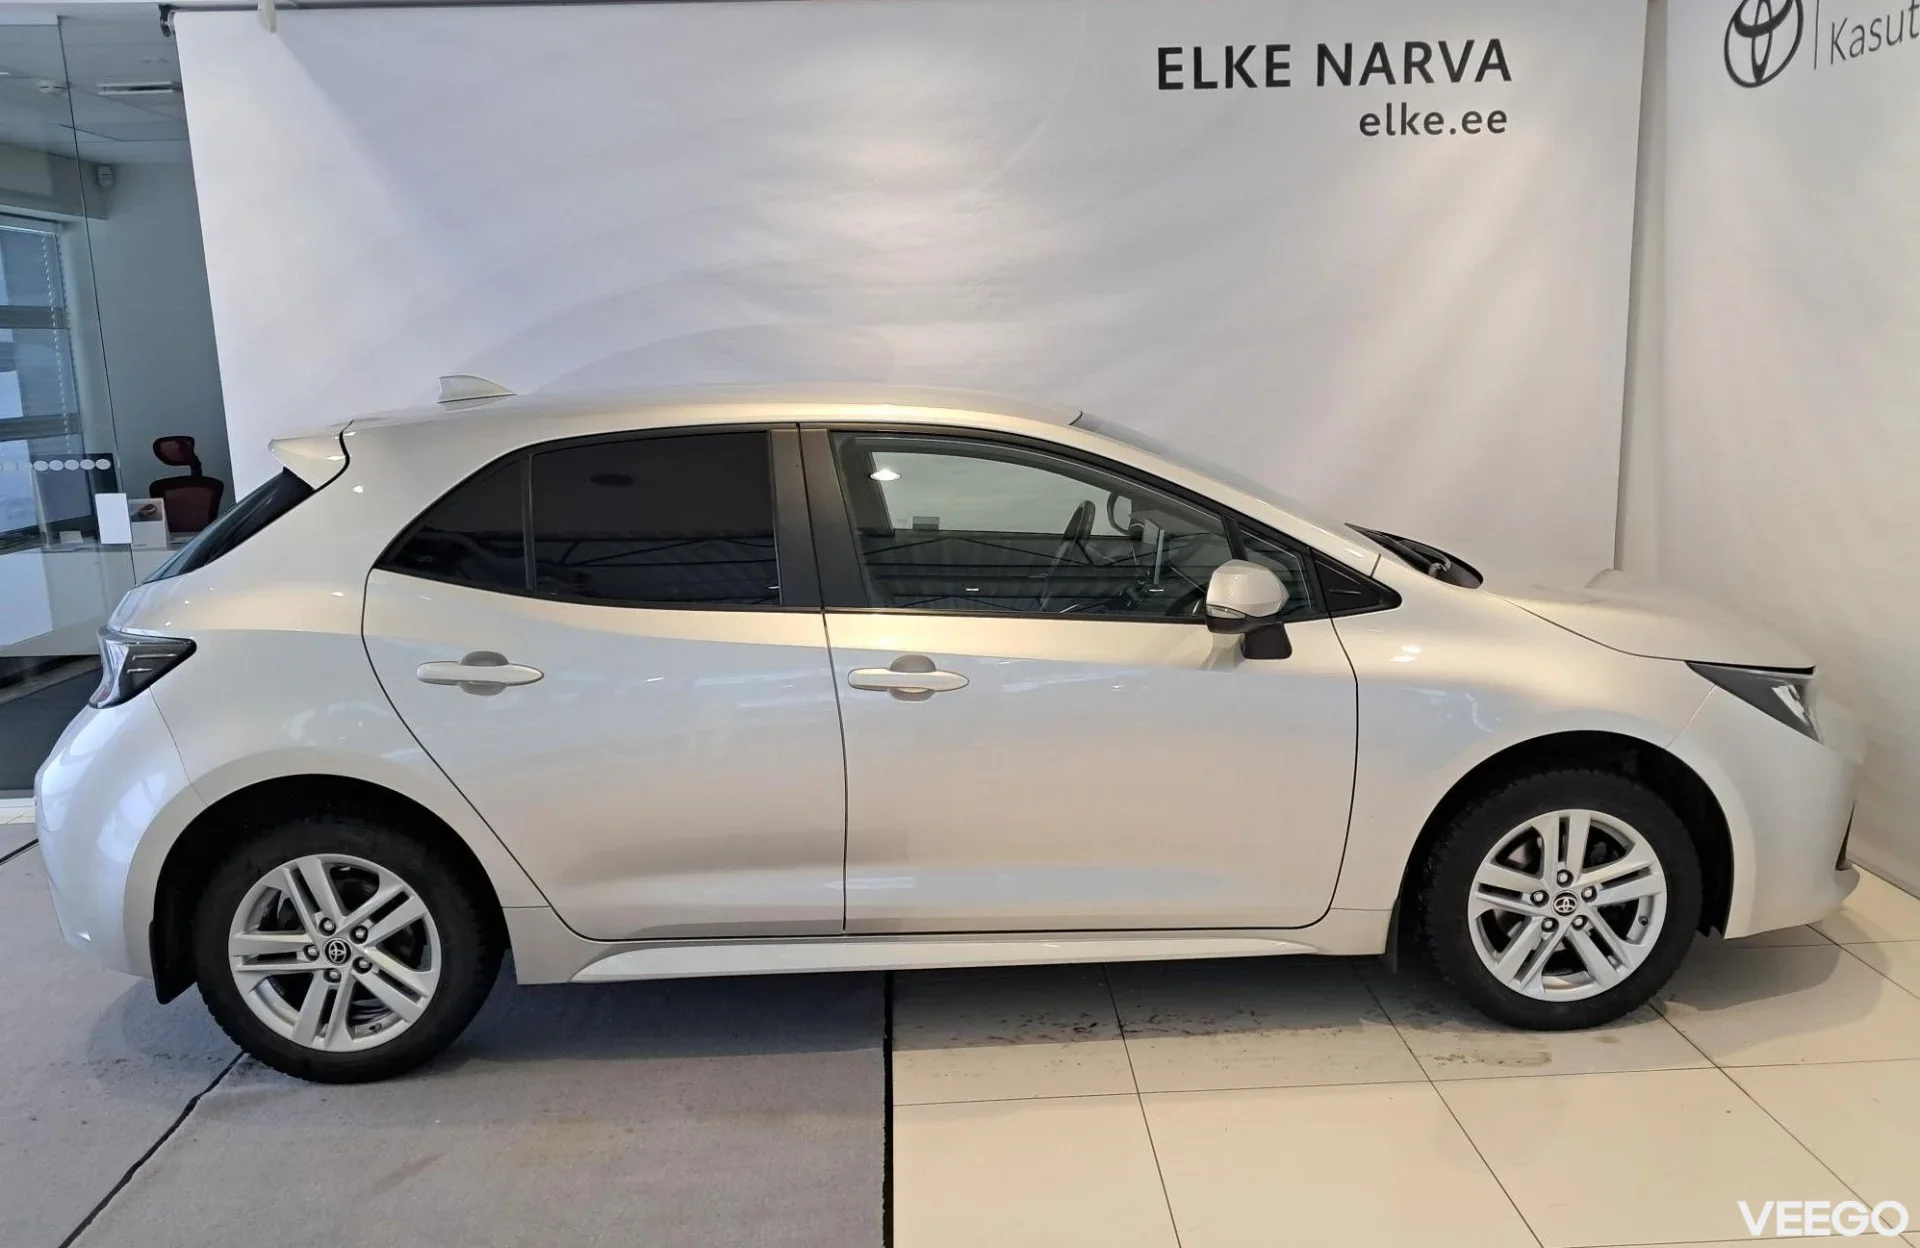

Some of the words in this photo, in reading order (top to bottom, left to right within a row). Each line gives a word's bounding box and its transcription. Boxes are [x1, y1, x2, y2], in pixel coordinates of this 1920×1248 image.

[1830, 0, 1920, 65] Kasut
[1157, 43, 1291, 90] ELKE
[1316, 38, 1512, 87] NARVA
[1359, 101, 1507, 137] elke.ee
